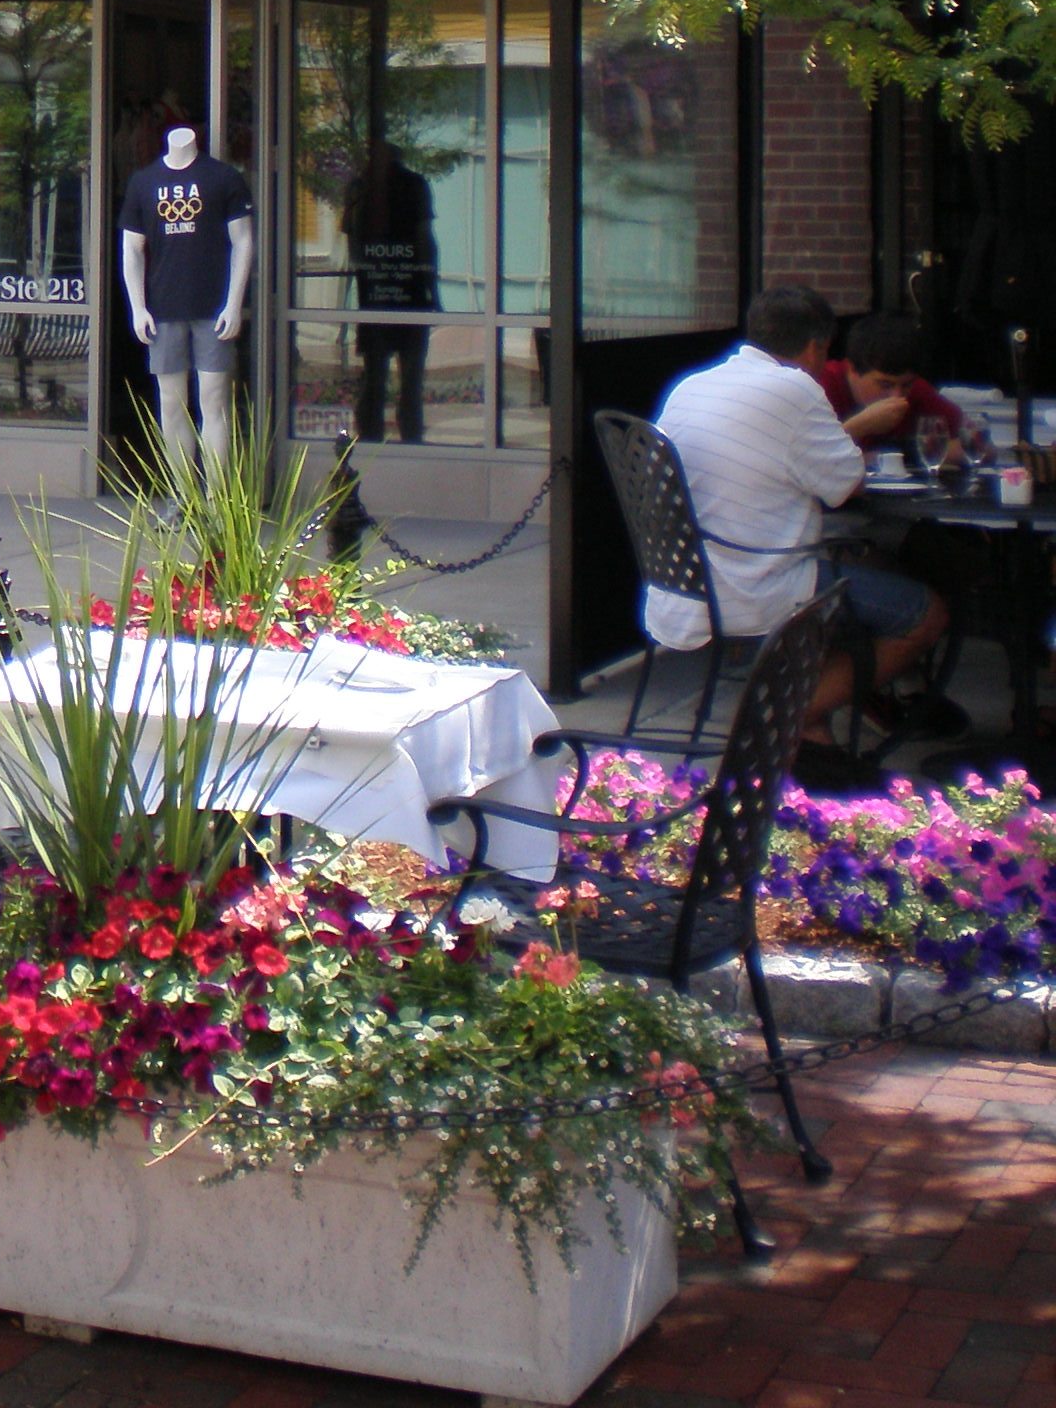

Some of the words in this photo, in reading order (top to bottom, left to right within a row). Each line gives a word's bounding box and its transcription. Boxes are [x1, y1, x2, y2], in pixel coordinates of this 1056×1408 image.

[165, 222, 195, 235] BEIJING
[364, 244, 415, 258] HOURS
[1, 275, 39, 300] Ste
[47, 277, 84, 301] 213
